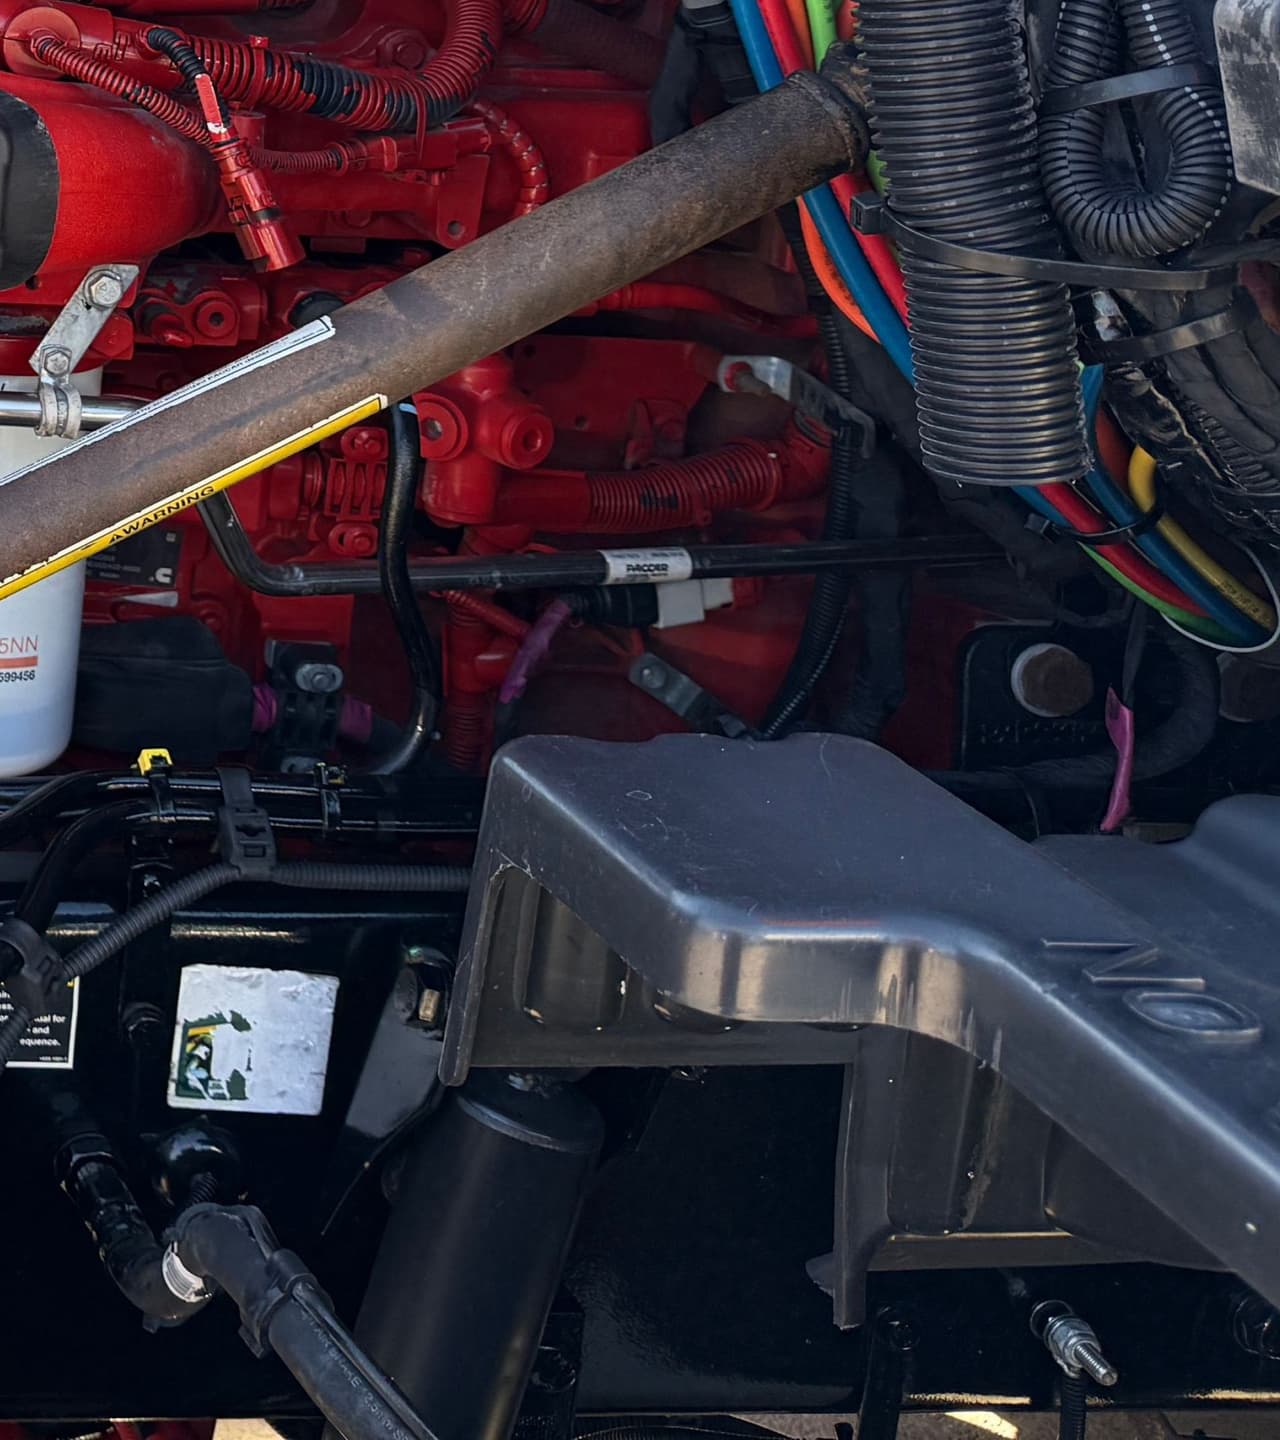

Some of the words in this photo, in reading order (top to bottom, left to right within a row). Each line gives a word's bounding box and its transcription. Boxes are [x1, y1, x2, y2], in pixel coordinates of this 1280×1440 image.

[121, 485, 216, 537] WARNING
[52, 1014, 67, 1023] for
[32, 1025, 50, 1034] and
[19, 1037, 61, 1047] equence.
